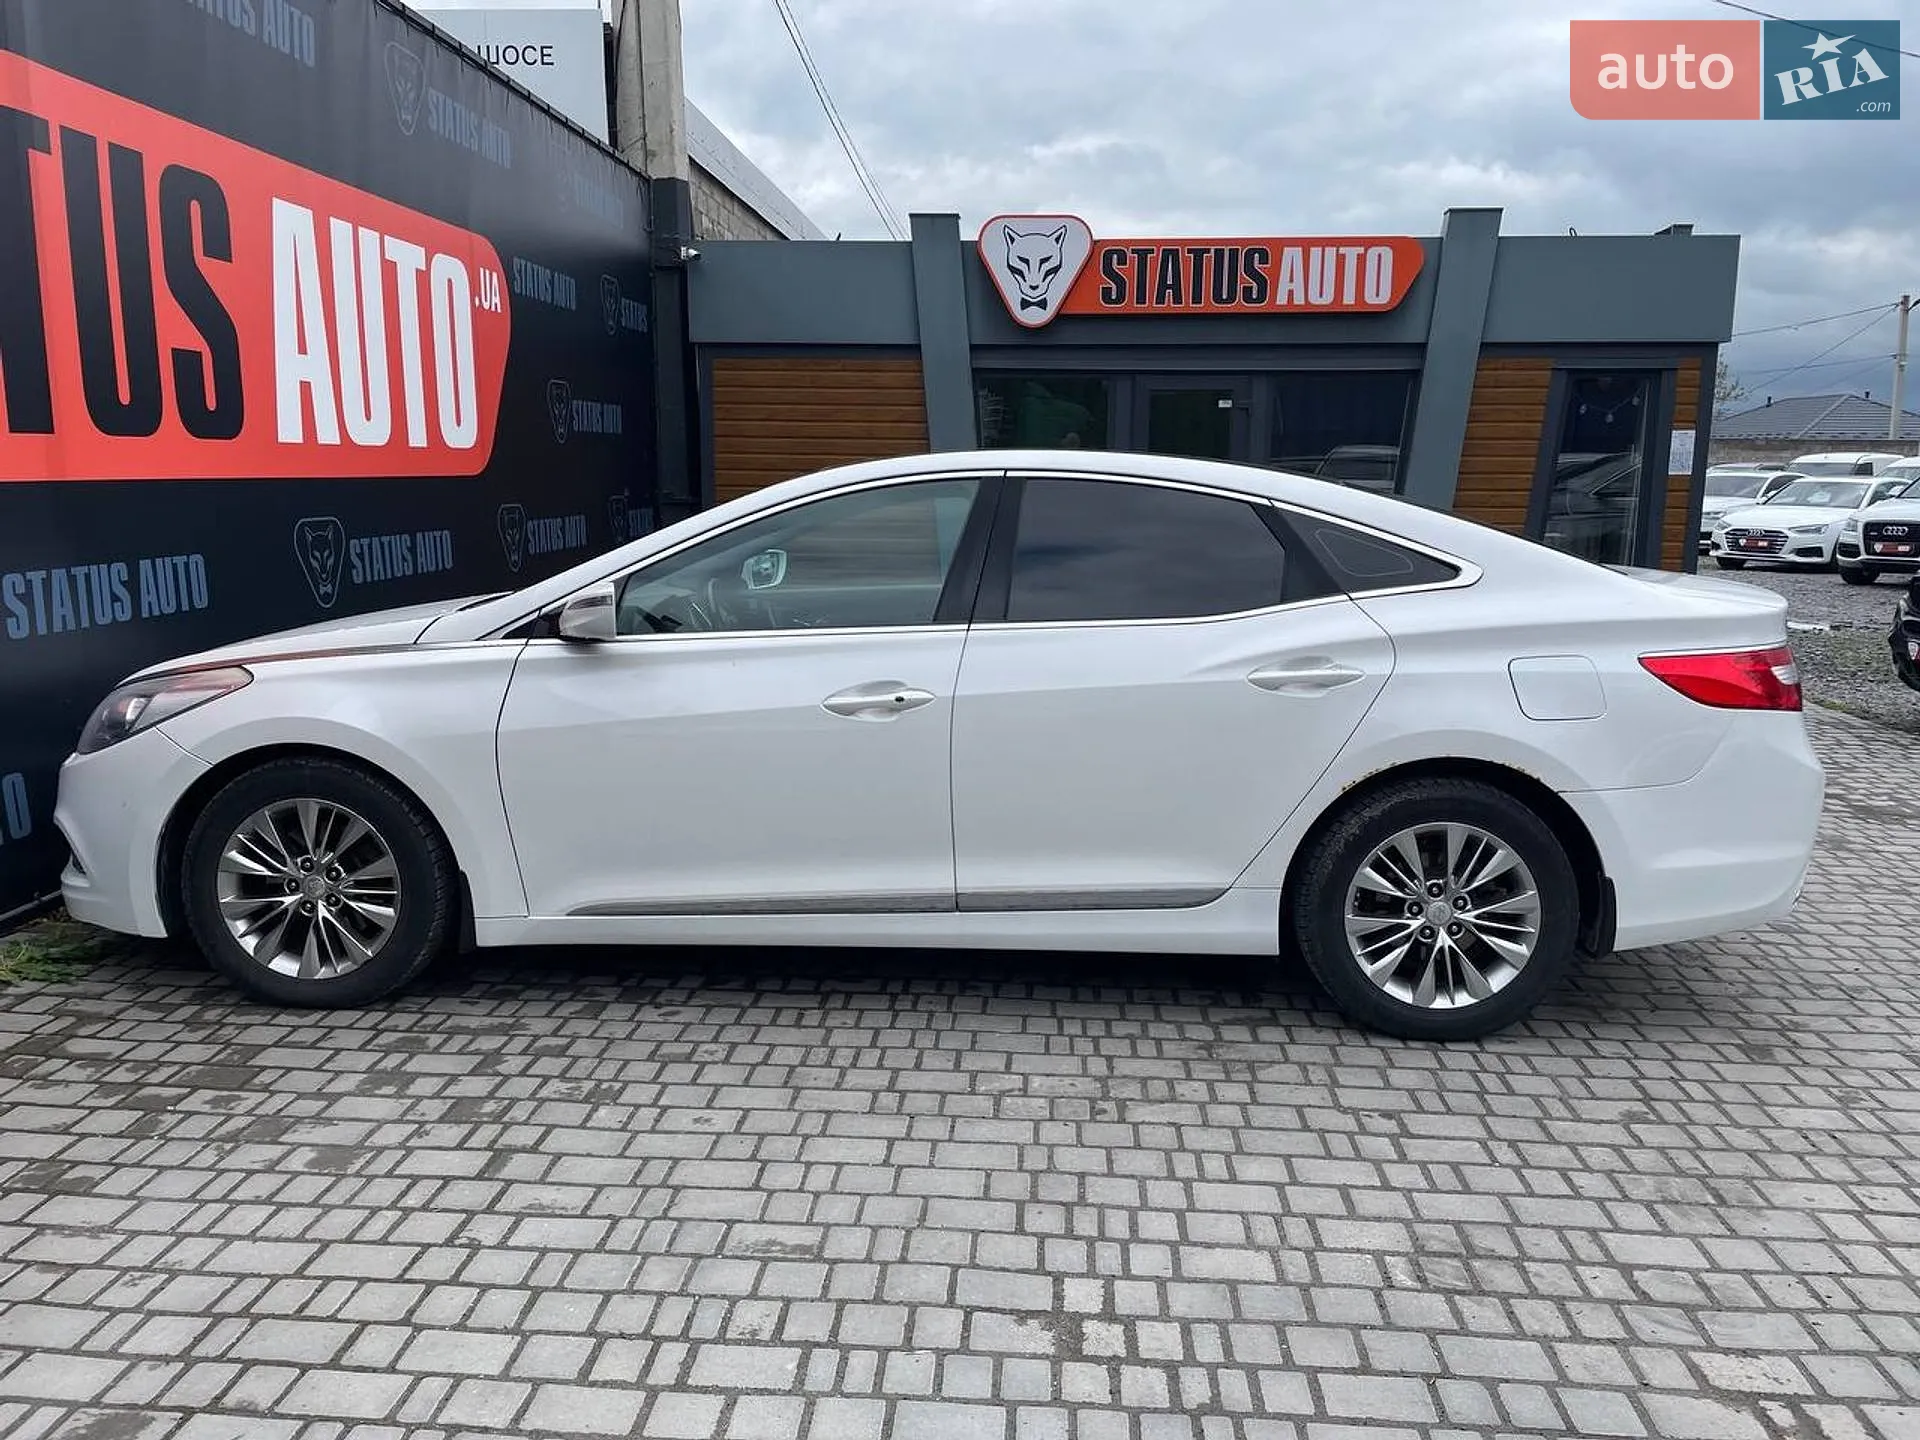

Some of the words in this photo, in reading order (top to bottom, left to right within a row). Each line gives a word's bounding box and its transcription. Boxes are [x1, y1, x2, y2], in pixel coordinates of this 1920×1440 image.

[262, 0, 316, 68] AUTO
[1100, 246, 1271, 306] STATUS
[1276, 245, 1394, 305] AUTO
[272, 196, 479, 450] AUTO
[475, 267, 502, 313] .UA
[350, 534, 413, 585] STATUS
[415, 529, 453, 574] AUTO
[2, 562, 132, 640] STATUS
[139, 553, 209, 619] AUTO
